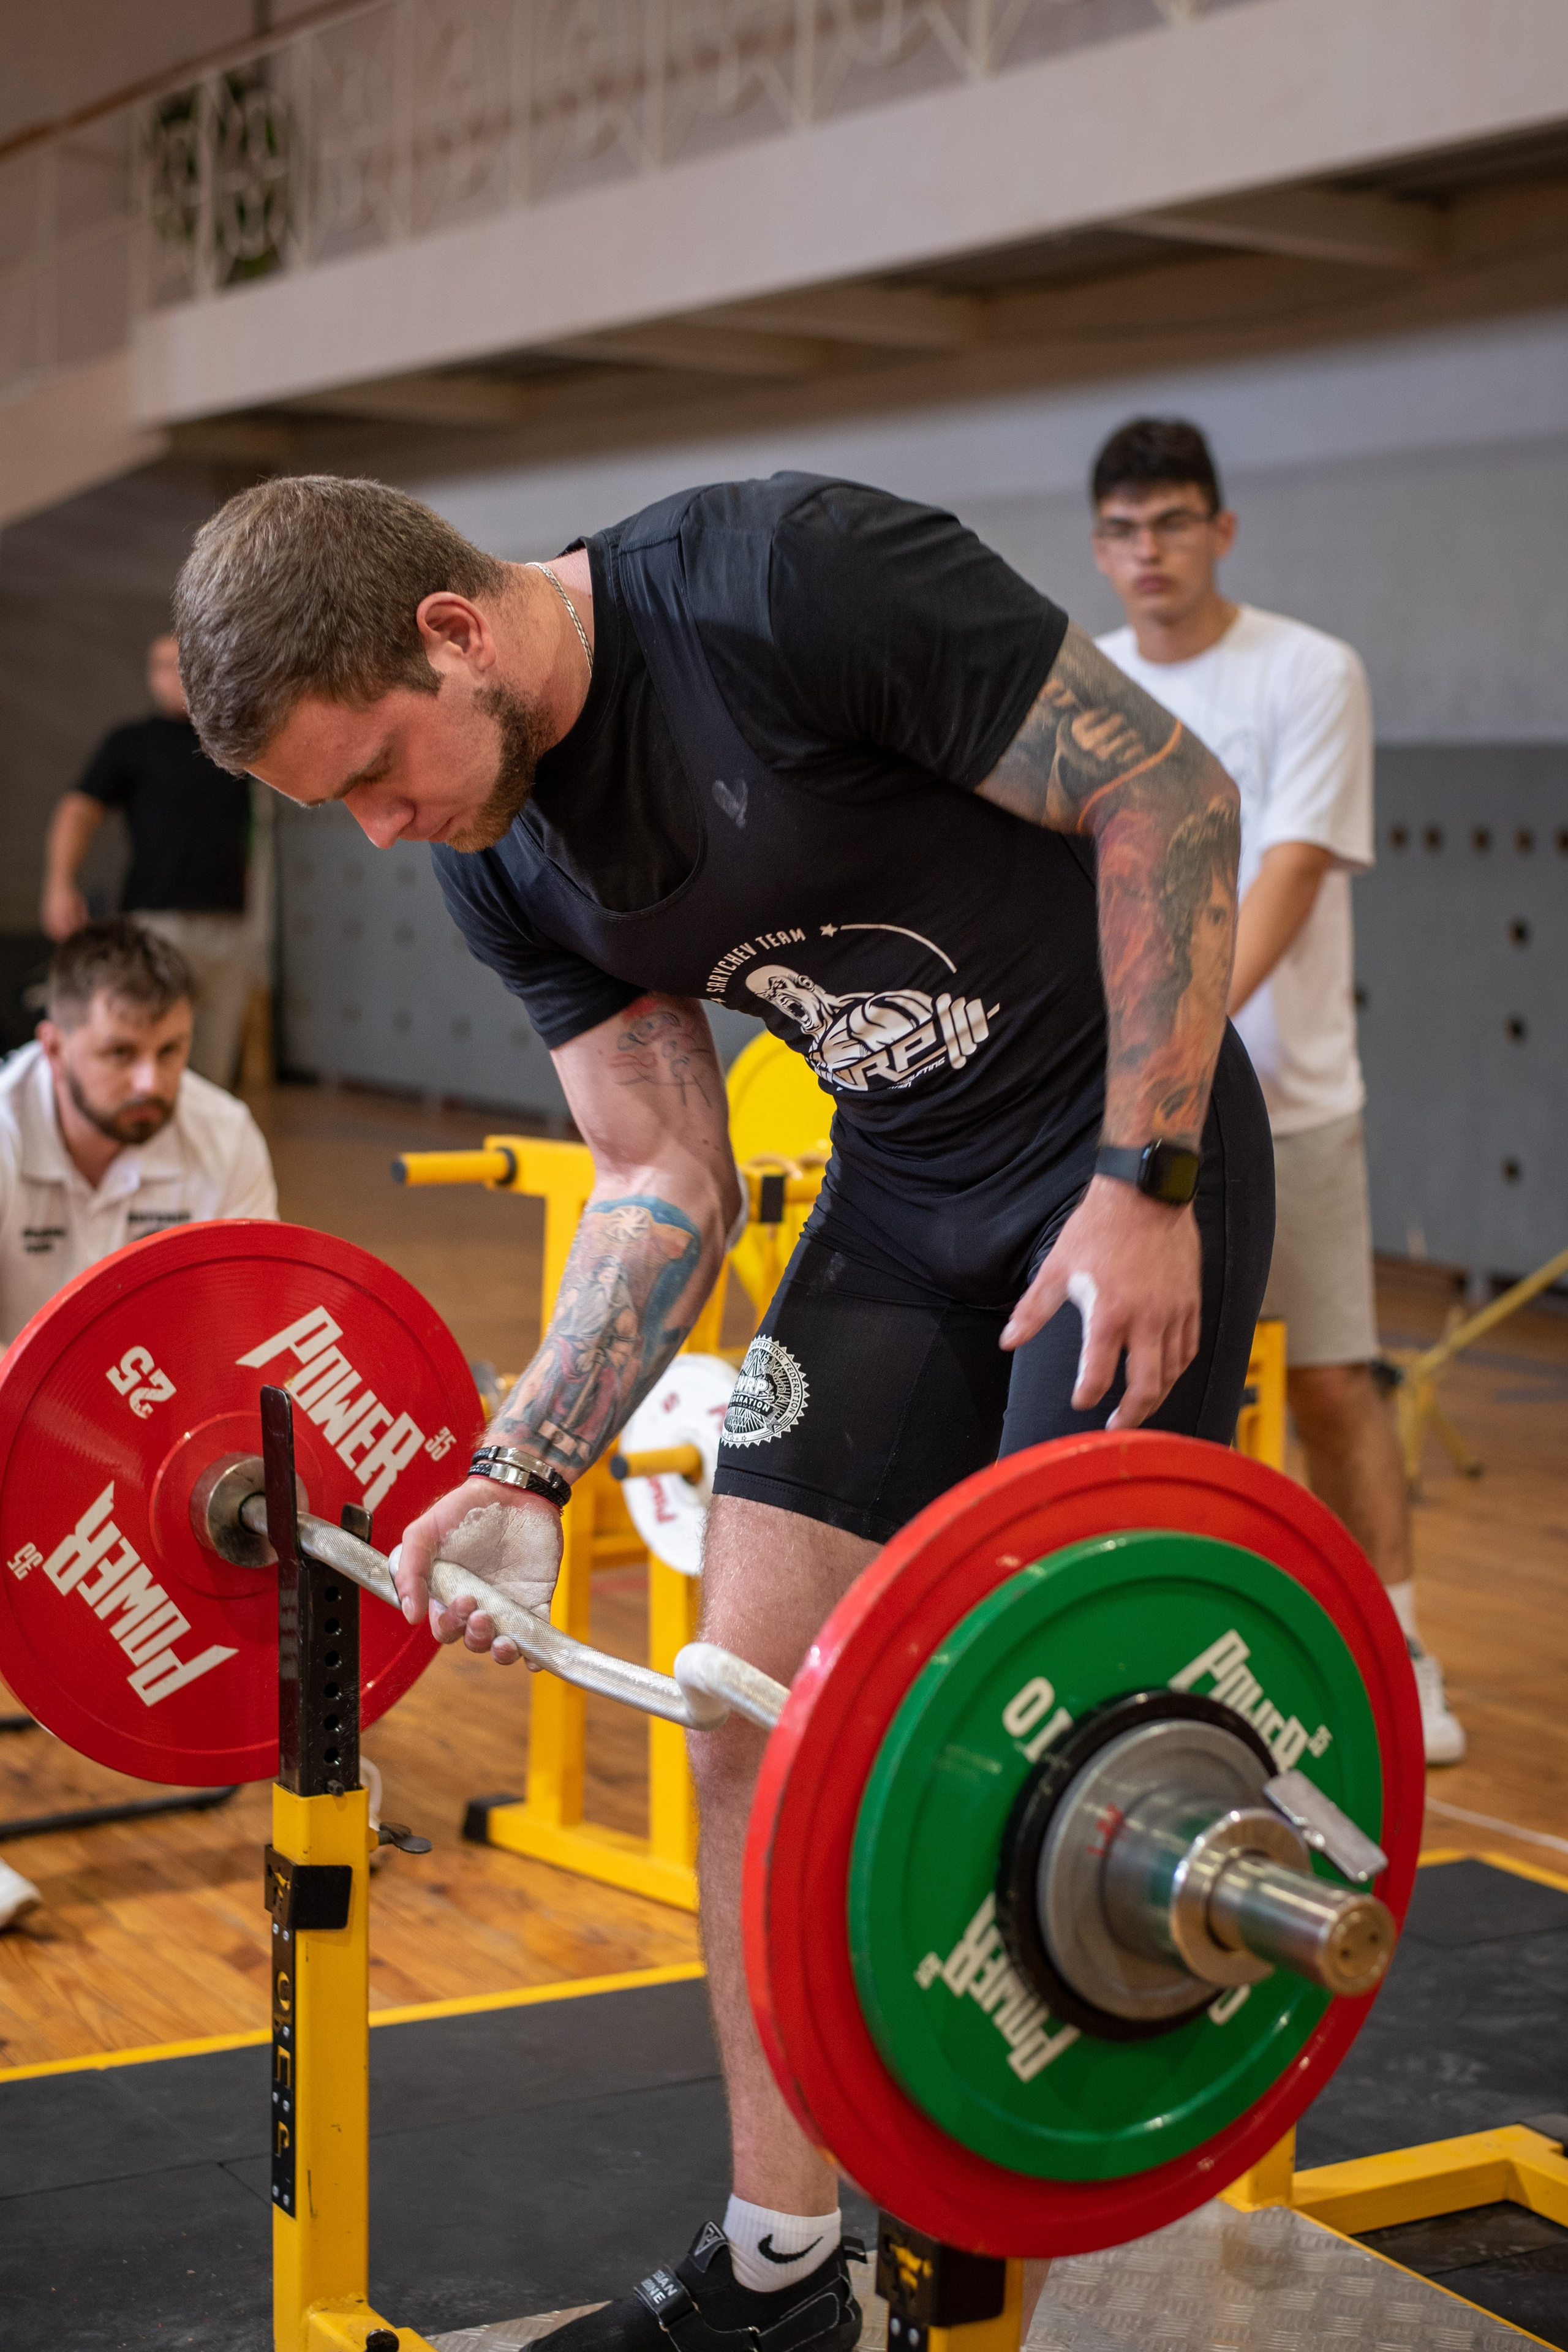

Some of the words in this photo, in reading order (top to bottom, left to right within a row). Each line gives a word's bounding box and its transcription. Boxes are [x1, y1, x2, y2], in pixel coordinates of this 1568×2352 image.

[706, 942, 757, 993] SARYCHEV
[755, 928, 806, 949] TEAM
[105, 1346, 177, 1419] 25
[235, 1306, 425, 1512] POWER
[785, 1362, 800, 1414] FEDERATION
[727, 1414, 750, 1428] RAW
[7, 1542, 43, 1580] 35
[43, 1480, 239, 1707] POWER
[1002, 1676, 1073, 1763] 10
